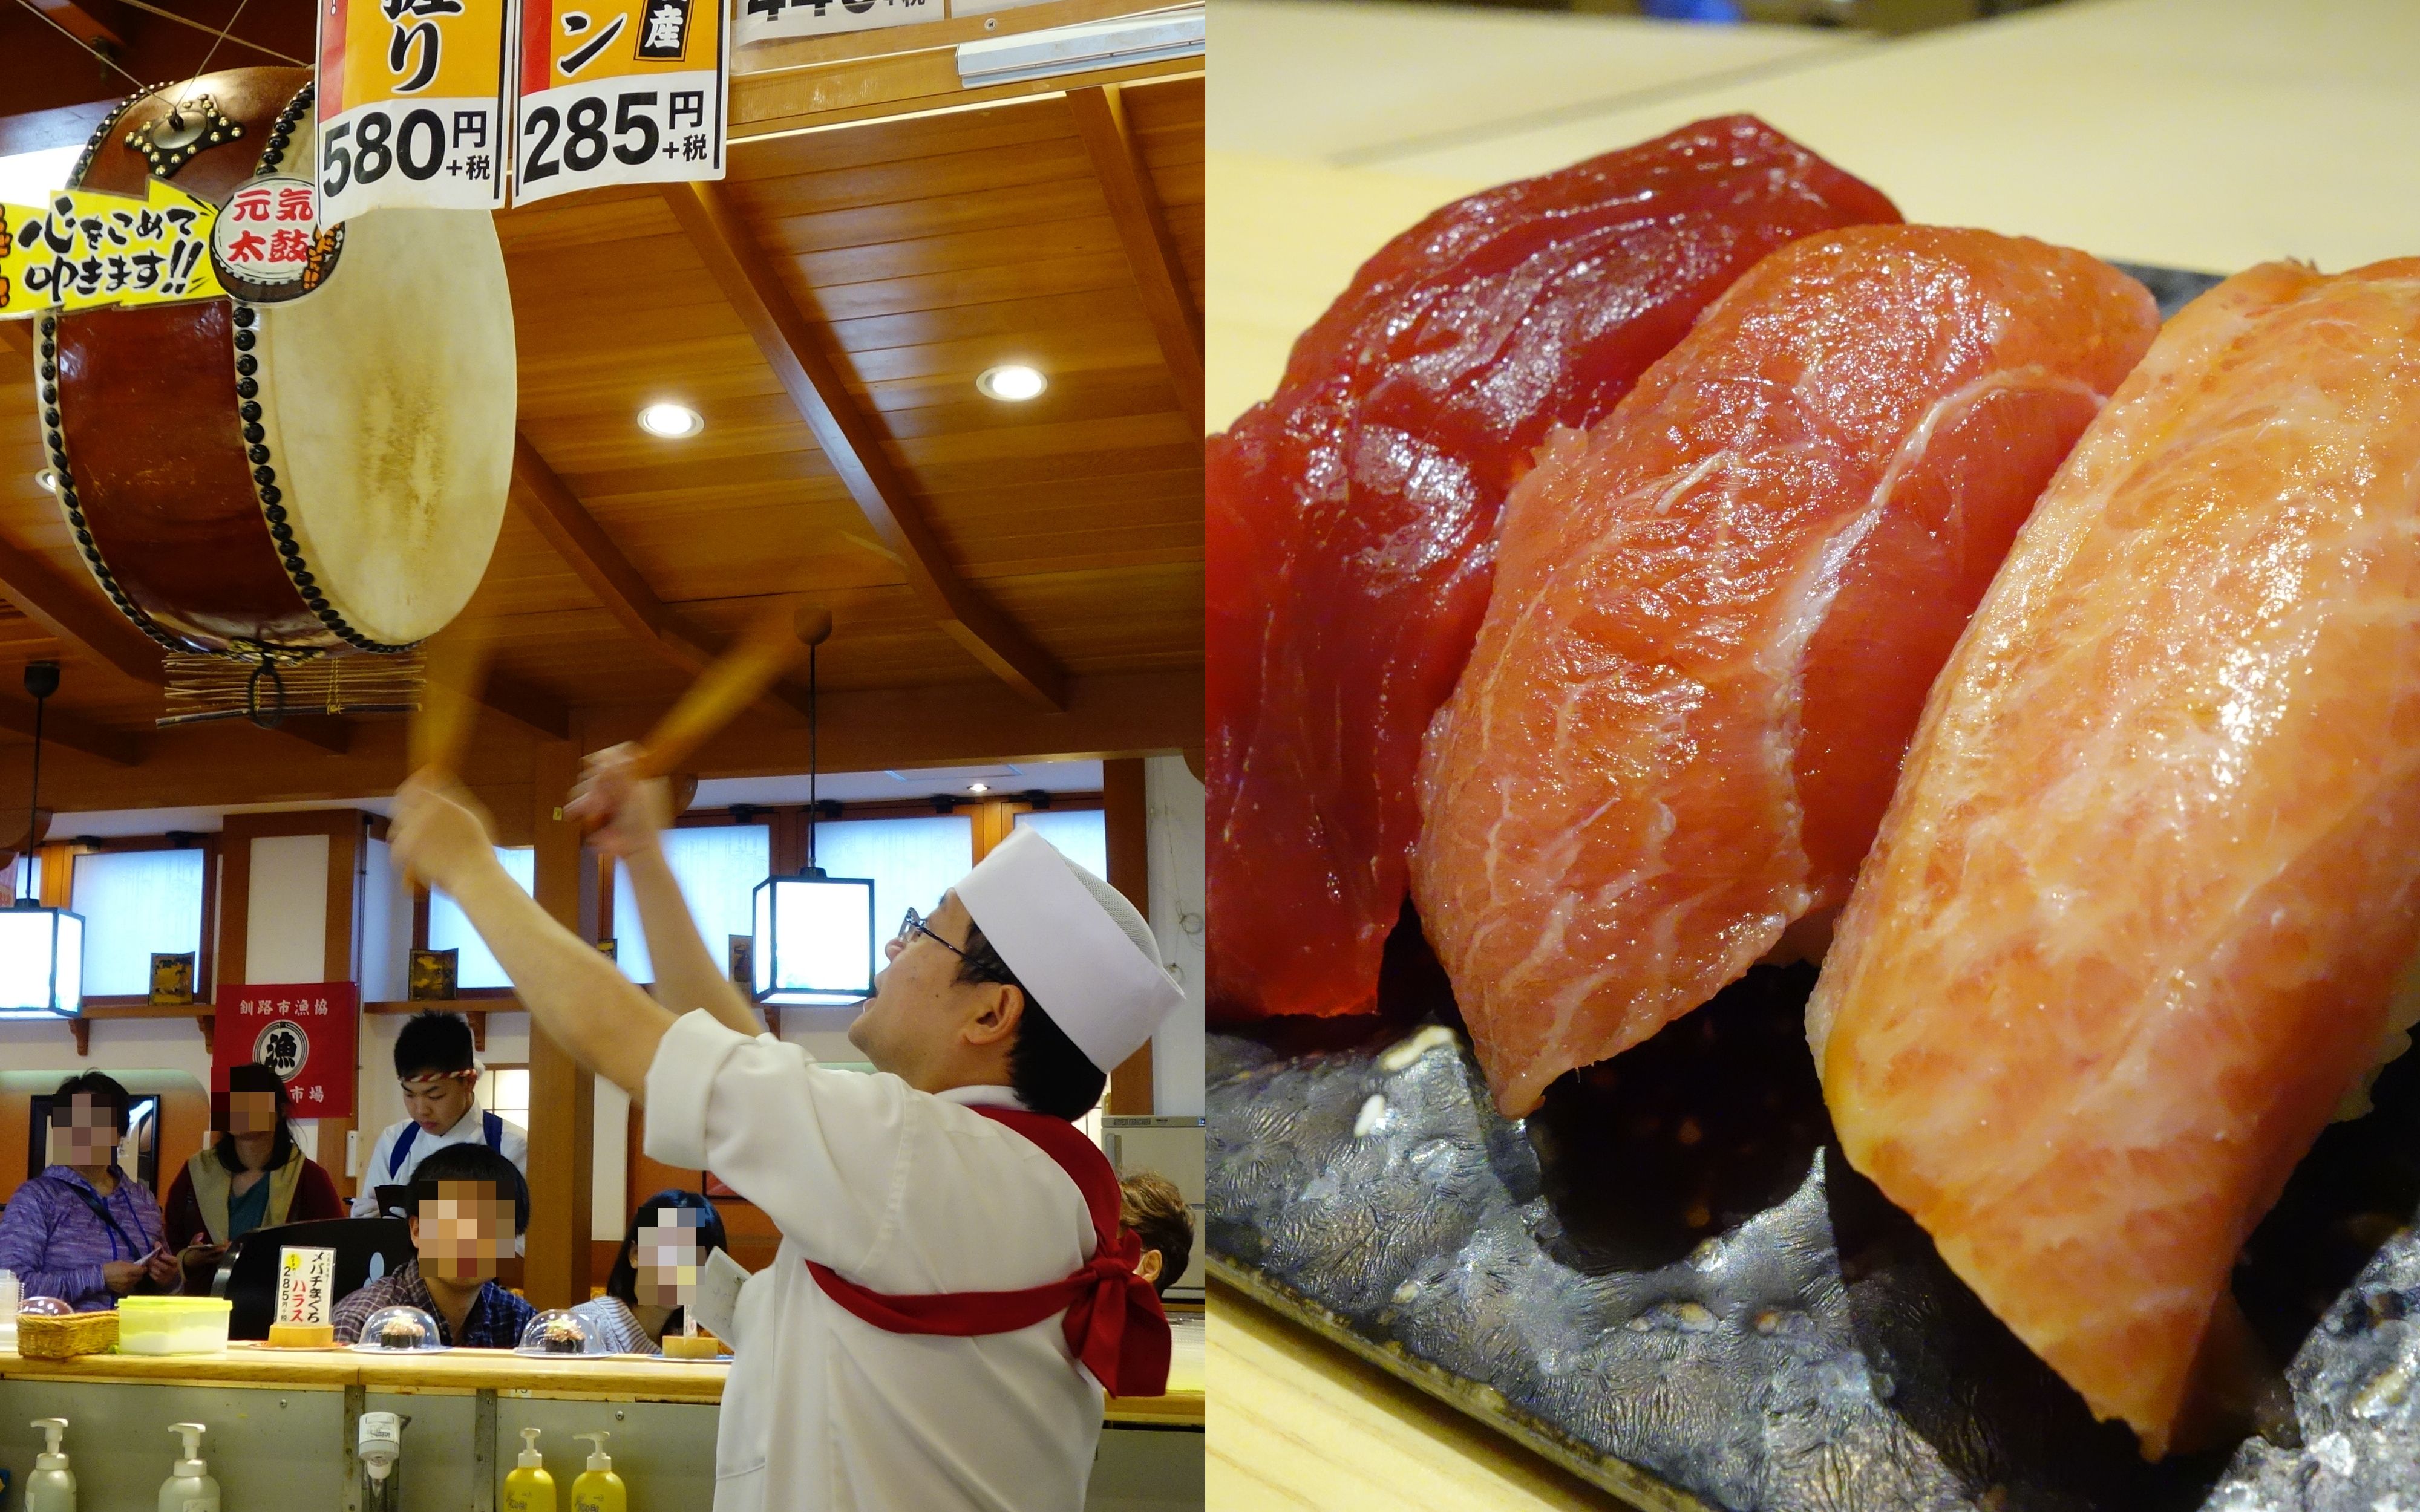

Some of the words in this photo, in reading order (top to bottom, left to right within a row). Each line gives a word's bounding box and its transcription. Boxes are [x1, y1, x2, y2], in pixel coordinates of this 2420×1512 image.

[644, 0, 687, 48] 産
[232, 187, 313, 223] 元気
[18, 197, 197, 253] 心をこめて
[227, 229, 309, 263] 太鼓
[240, 999, 328, 1016] 釧路市漁協
[264, 1032, 296, 1069] 漁
[290, 1086, 324, 1103] 市場
[290, 1279, 306, 1323] ハラス
[307, 1251, 324, 1323] メバチまぐろ
